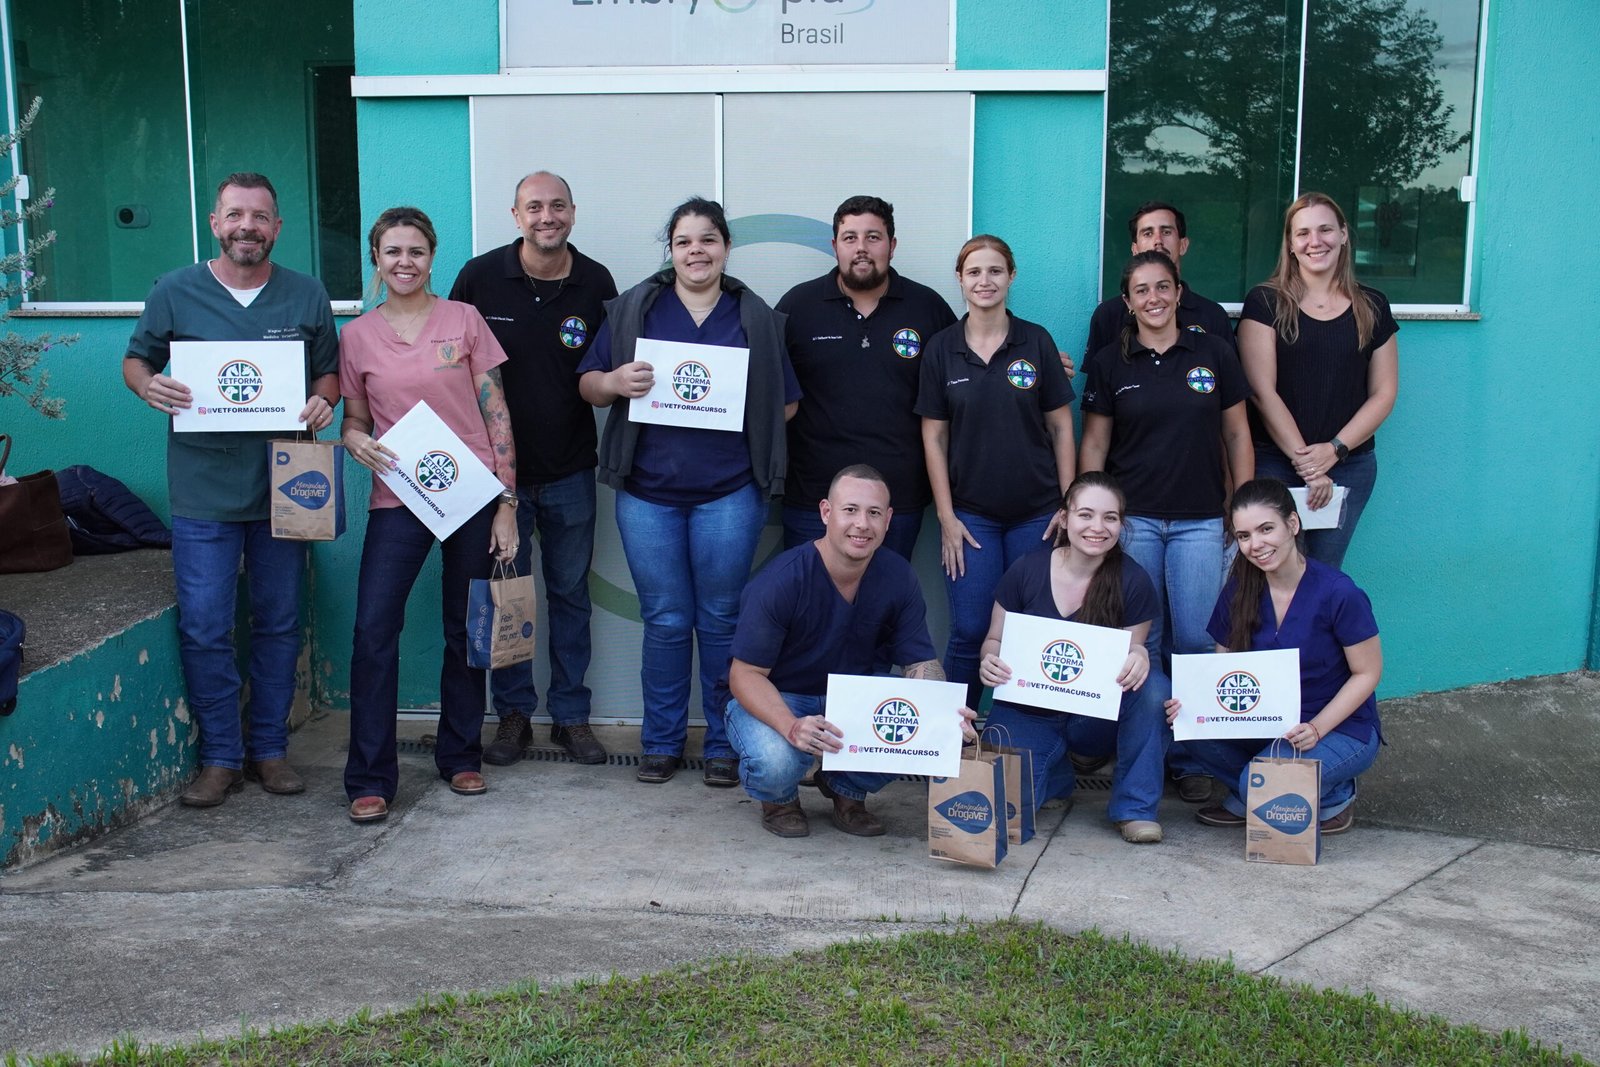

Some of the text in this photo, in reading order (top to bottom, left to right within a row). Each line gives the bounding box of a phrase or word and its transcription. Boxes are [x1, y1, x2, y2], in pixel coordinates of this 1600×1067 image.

[781, 23, 843, 44] Brasil
[217, 377, 263, 385] VETFORMA
[672, 376, 711, 385] VETFORMA
[207, 406, 286, 414] @VETFORMACURSOS
[660, 402, 727, 413] @VETFORMACURSOS
[423, 454, 453, 488] VETFORMA
[290, 487, 326, 499] DrogaVET
[394, 466, 445, 518] @VETFORMACURSOS
[1041, 654, 1084, 667] VETFORMA
[1026, 682, 1101, 699] @VETFORMACURSOS
[1216, 687, 1260, 695] VETFORMA
[873, 716, 919, 725] VETFORMA
[858, 746, 939, 756] @VETFORMACURSOS
[952, 801, 989, 812] Manipulado
[1271, 804, 1308, 812] Manipulado
[948, 807, 988, 821] DrogaVET
[1266, 810, 1307, 823] DrogaVET
